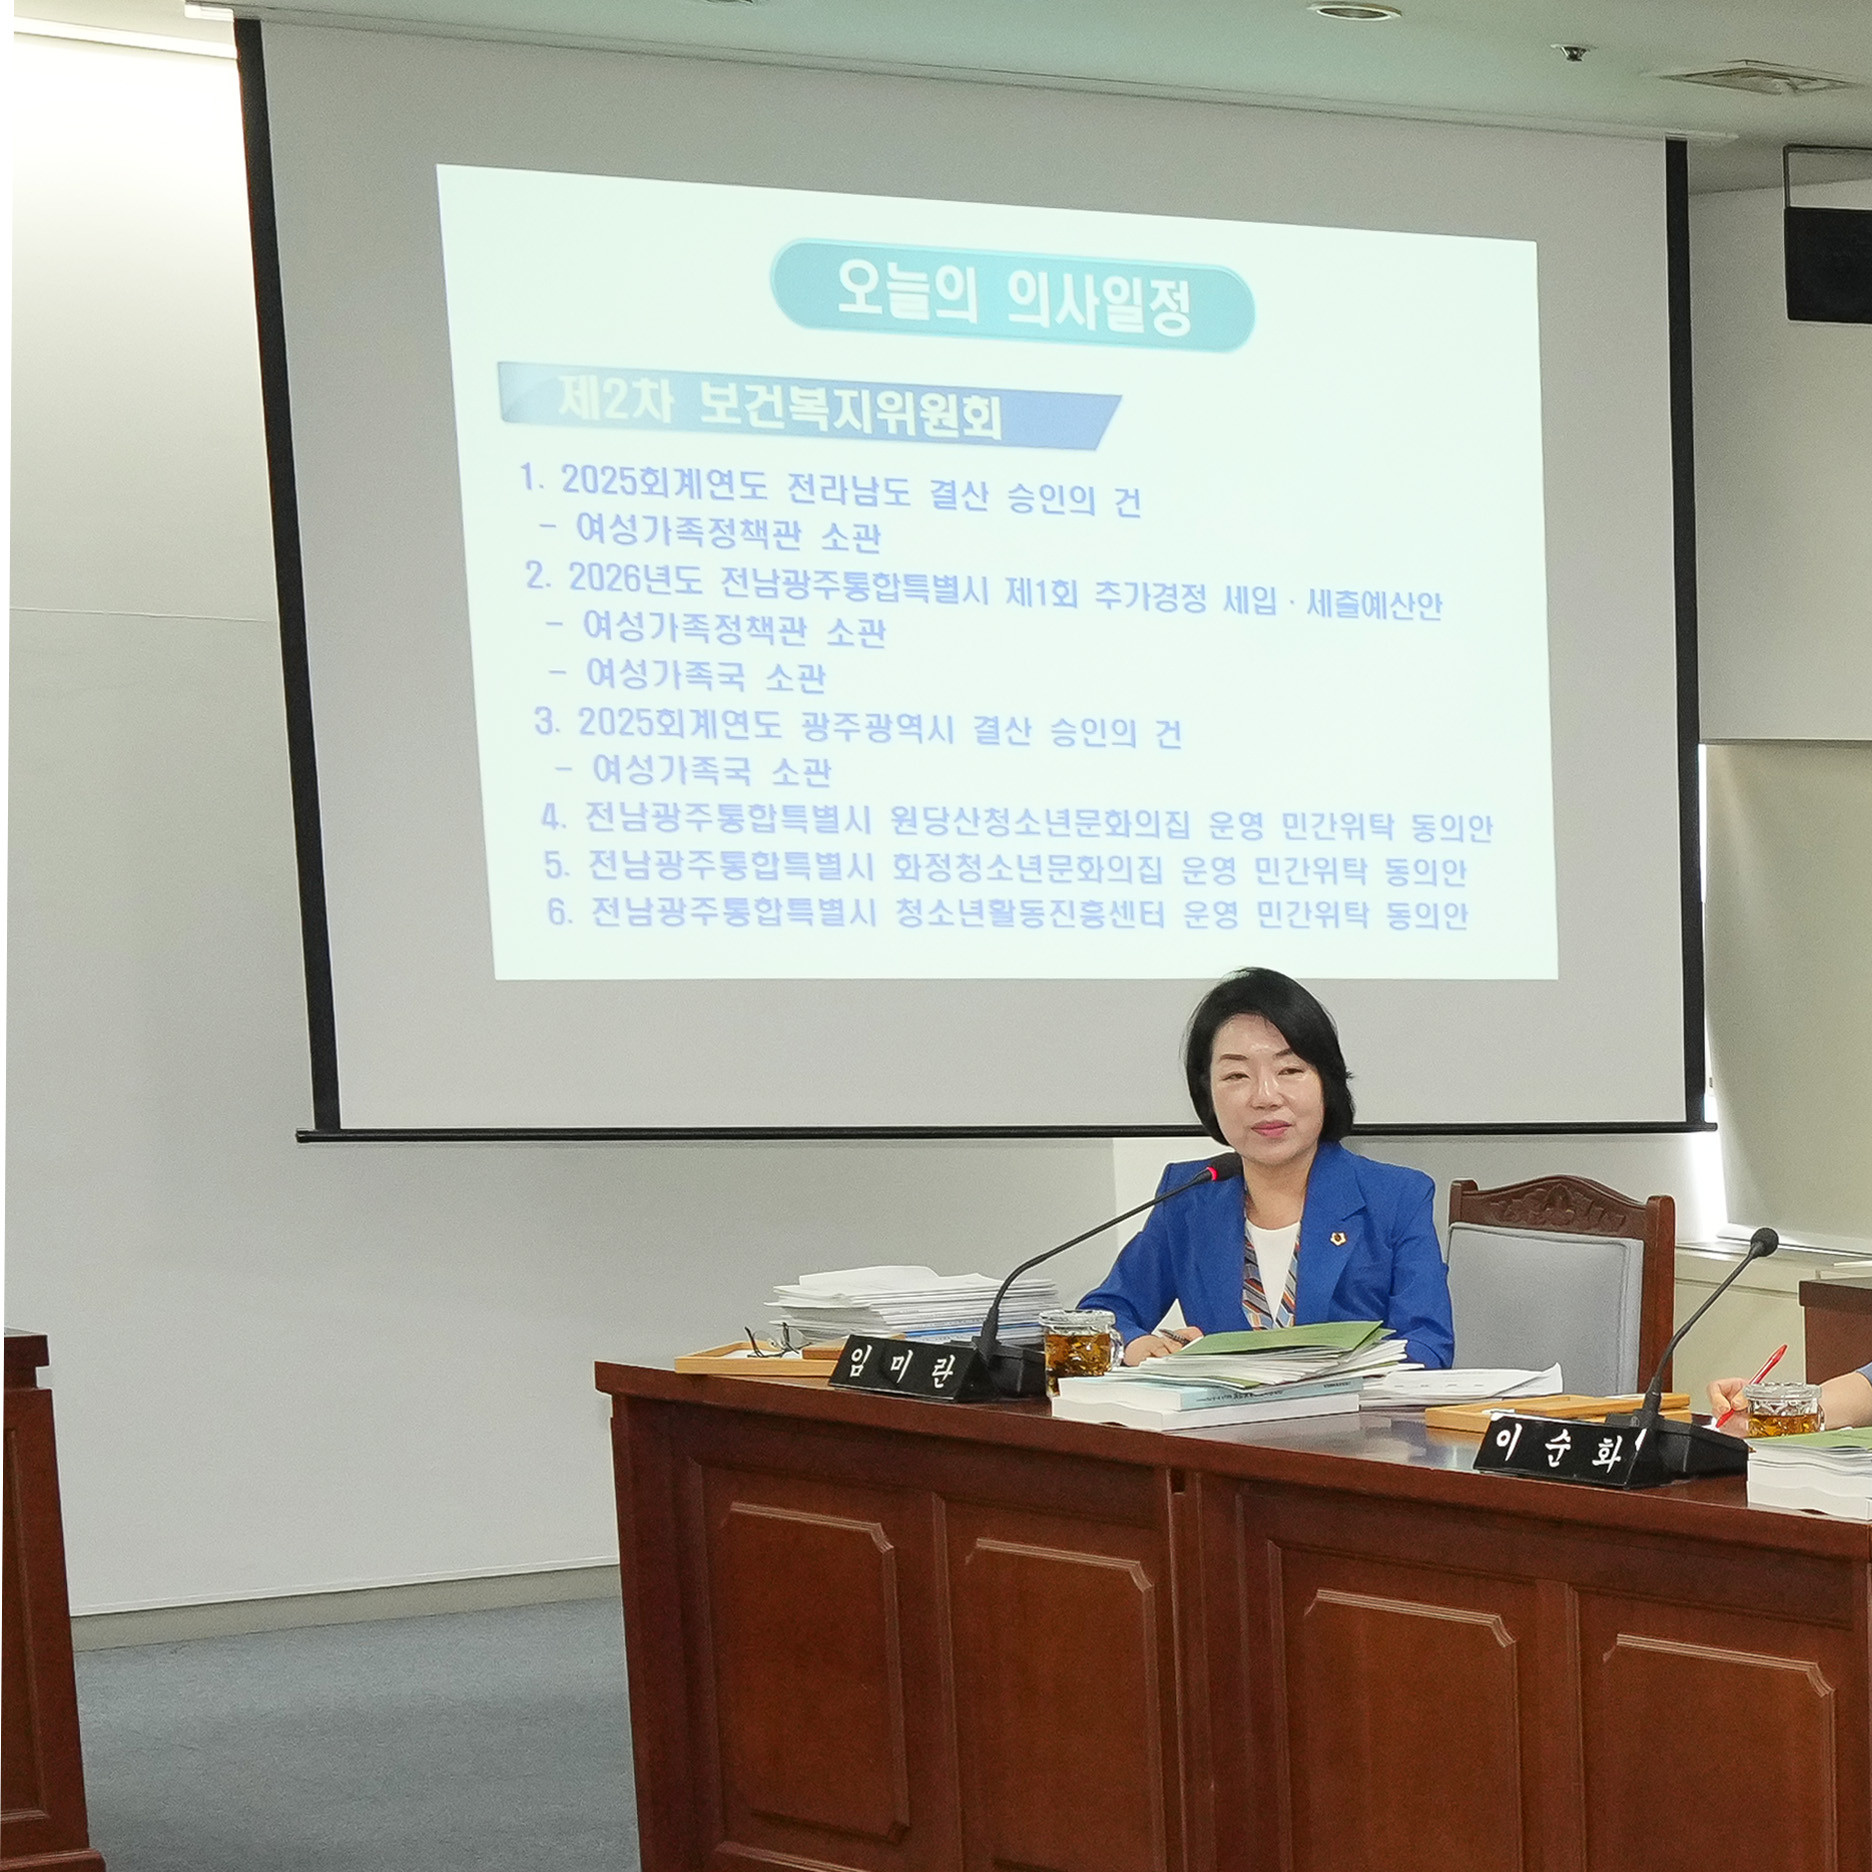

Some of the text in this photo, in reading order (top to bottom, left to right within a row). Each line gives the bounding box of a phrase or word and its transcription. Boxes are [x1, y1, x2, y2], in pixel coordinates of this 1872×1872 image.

[838, 258, 1192, 337] 오늘의 의사일정
[558, 375, 1002, 439] 제2차 보건복지위원회
[520, 461, 1141, 519] 1. 2025회계연도 전라남도 결산 승인의 건
[575, 511, 803, 552] 여성가족정책관
[821, 522, 882, 555] 소관
[525, 559, 552, 590] 2.
[568, 560, 704, 596] 2026년도
[721, 566, 989, 606] 전남광주통합특별시
[1005, 576, 1079, 610] 제1회
[1095, 580, 1207, 615] 추가경정
[1223, 584, 1277, 617] 세입
[1306, 588, 1444, 622] 세출예산안
[582, 609, 808, 647] 여성가족정책관
[826, 617, 887, 650] 소관
[586, 657, 745, 693] 여성가족국
[766, 663, 827, 696] 소관
[533, 705, 1182, 751] 3. 2025회계연도 광주광역시 결산 승인의 건
[592, 753, 752, 787] 여성가족국
[772, 757, 833, 789] 소관
[540, 801, 1494, 844] 4. 전남광주통합특별시 원당산청소년문화의집 운영 민간위탁 동의안
[544, 849, 1468, 888] 5. 전남광주통합특별시 화정청소년문화의집 운영 민간위탁 동의안
[547, 896, 1469, 932] 6. 전남광주통합특별시 청소년활동진흥센터 운영 민간위탁 동의안
